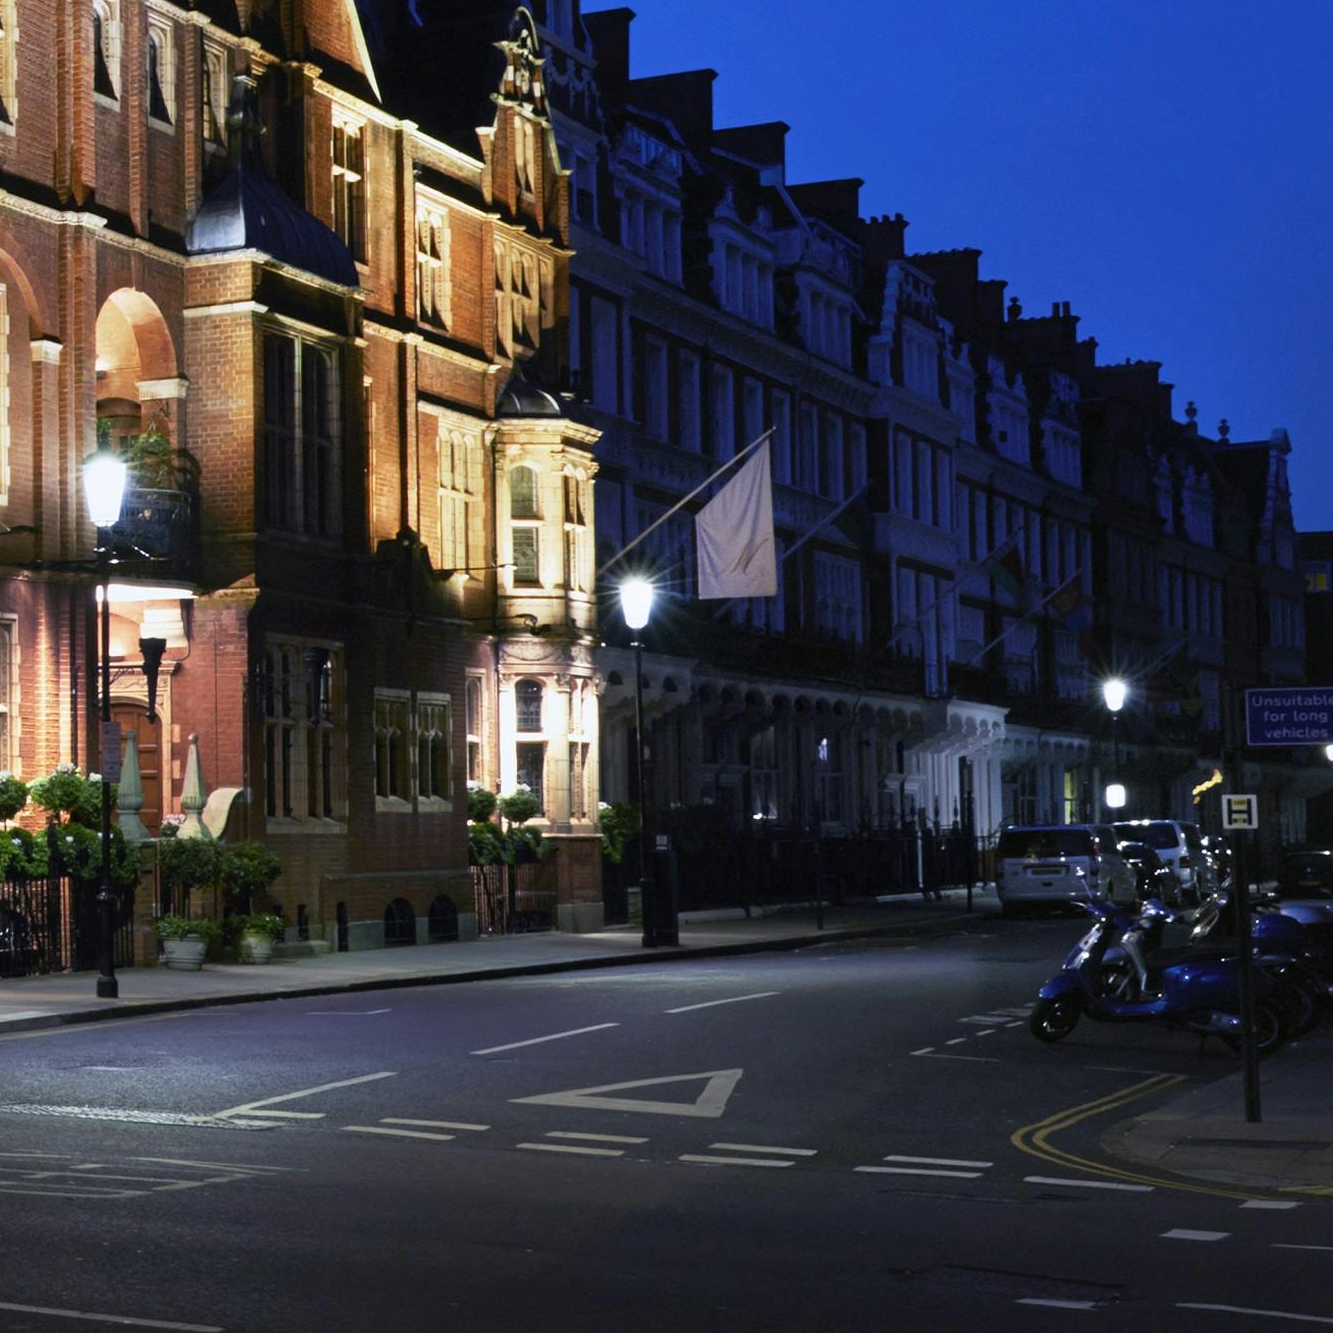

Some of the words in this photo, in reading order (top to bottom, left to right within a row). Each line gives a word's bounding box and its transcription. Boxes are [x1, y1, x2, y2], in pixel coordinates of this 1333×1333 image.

[1252, 695, 1333, 707] Unsuitable
[1263, 710, 1285, 722] for
[1293, 710, 1328, 723] long
[1264, 726, 1328, 739] vehicles
